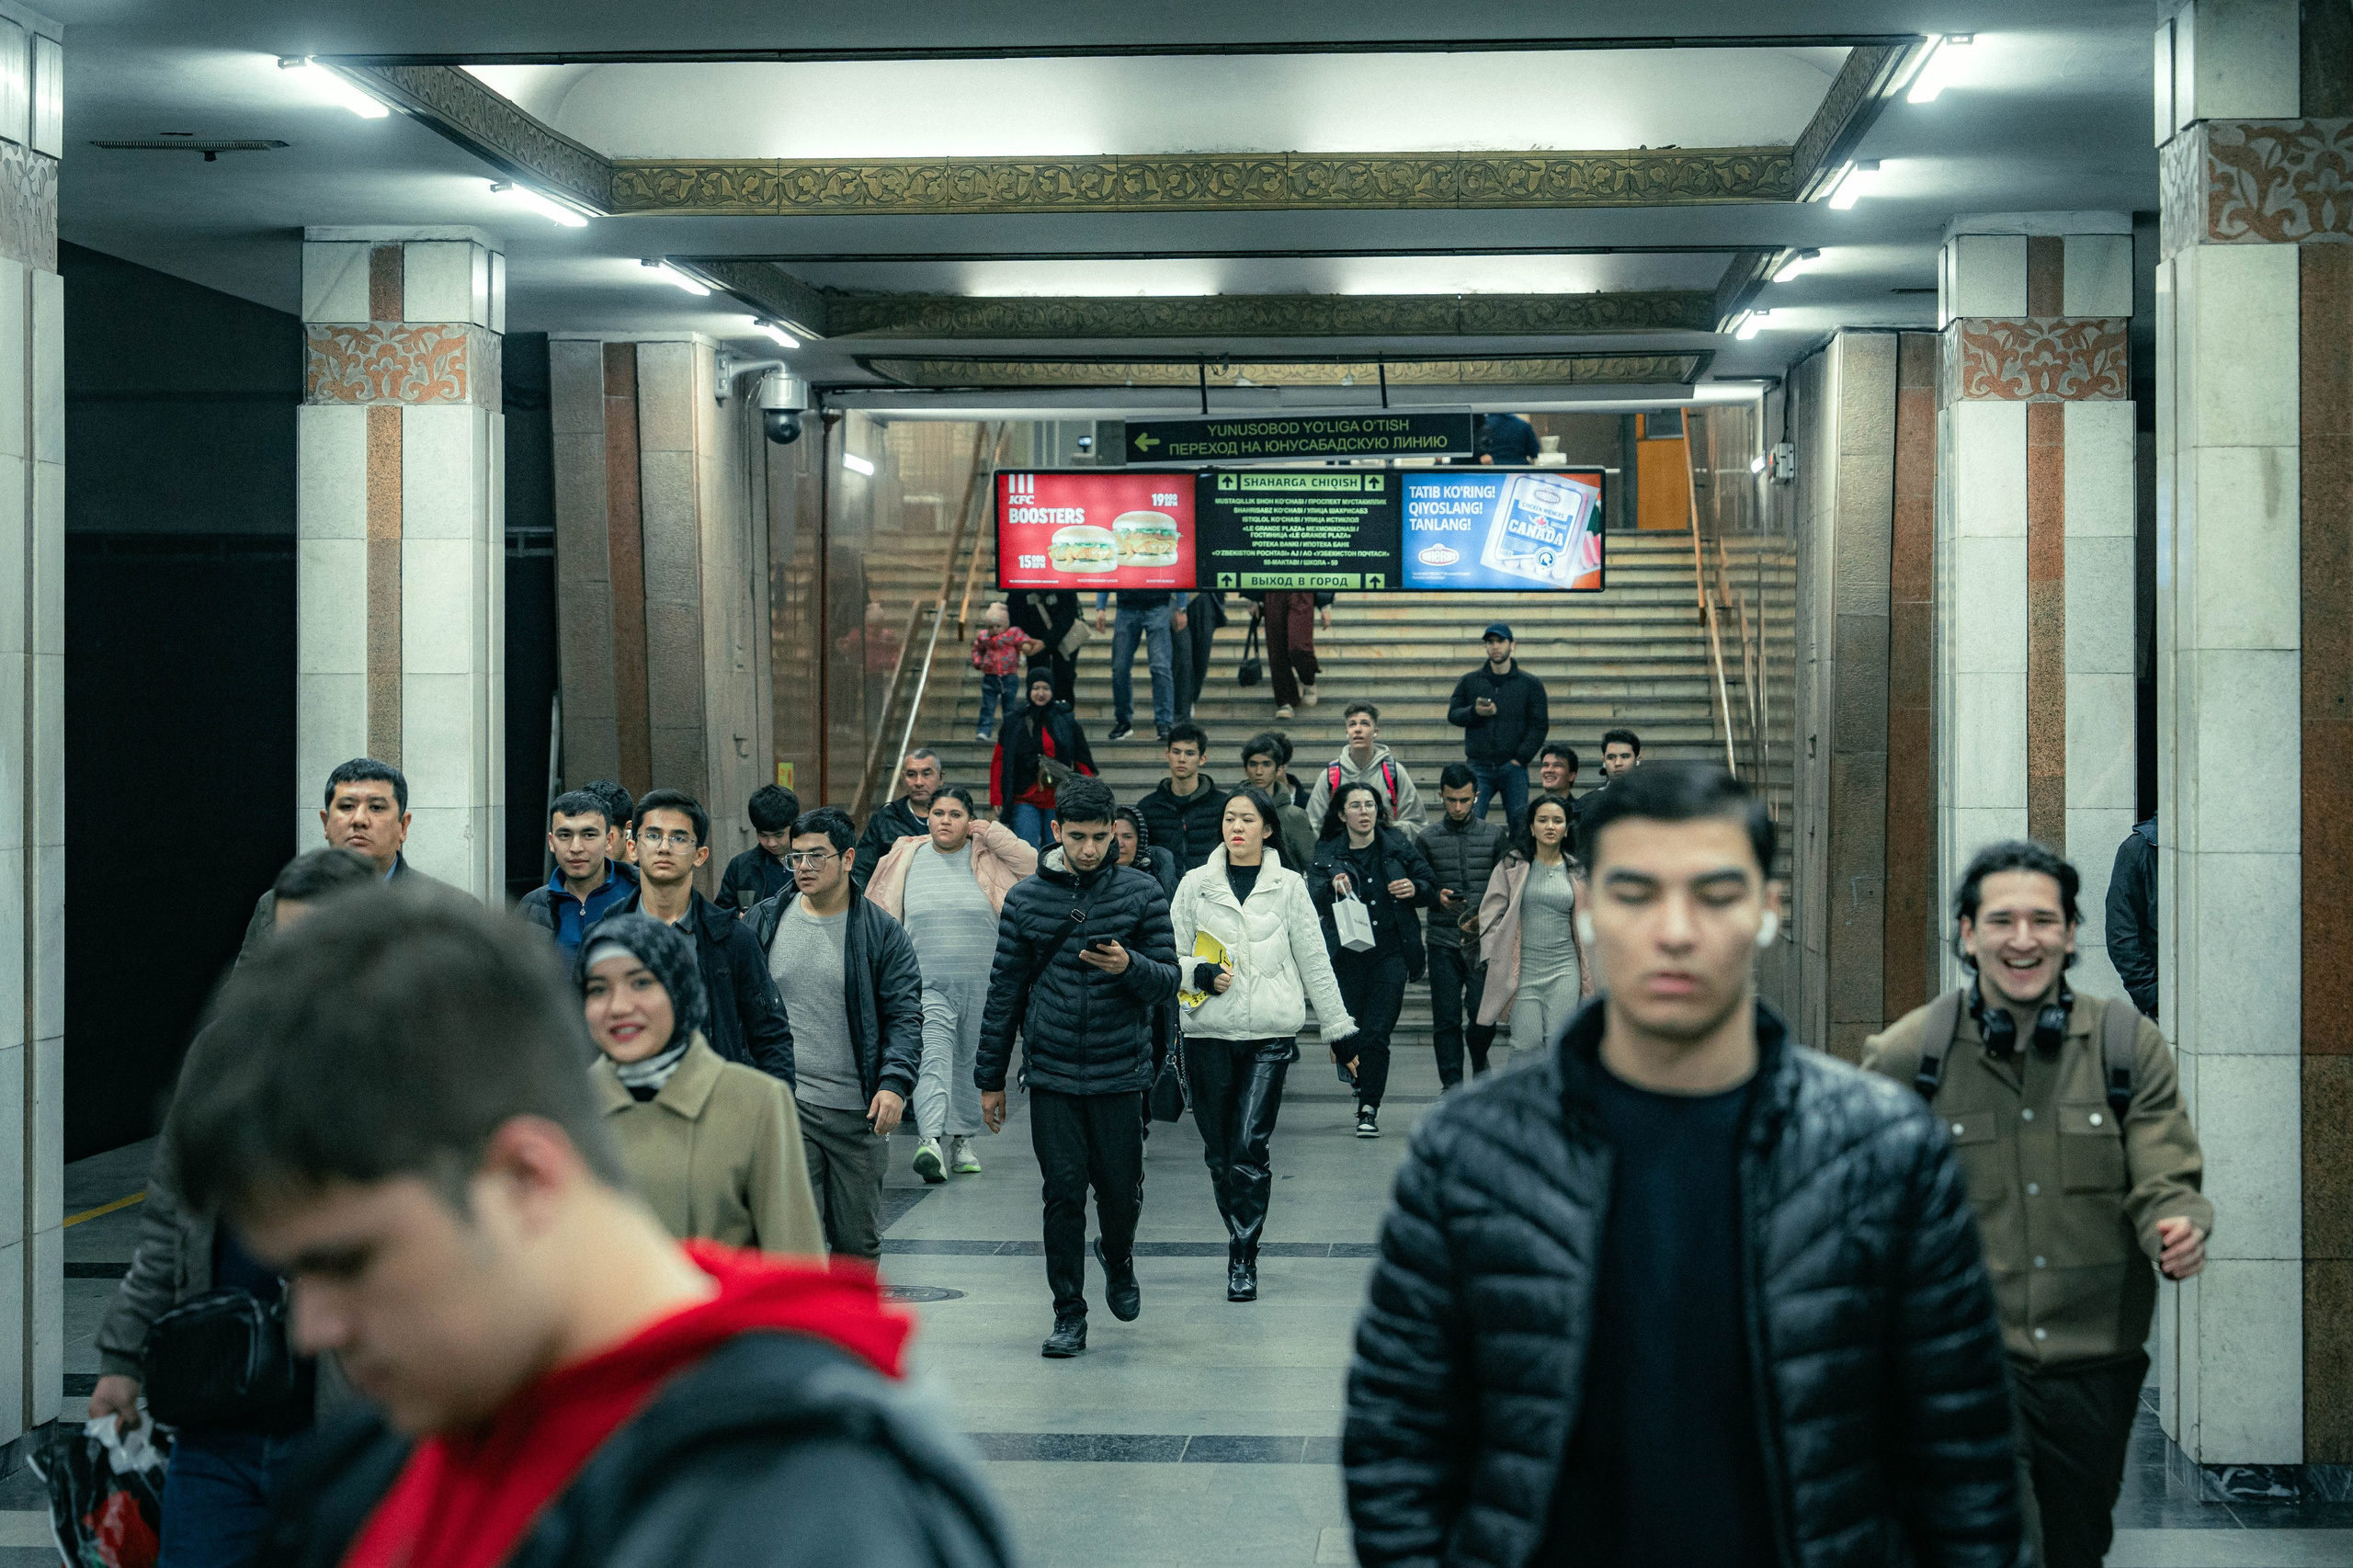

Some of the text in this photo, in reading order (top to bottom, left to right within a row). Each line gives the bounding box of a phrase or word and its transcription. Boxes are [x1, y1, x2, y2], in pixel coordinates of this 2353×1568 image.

[1207, 422, 1300, 437] YUNUSOBOD
[1169, 435, 1448, 456] ПЕРЕХОД НА ЮНУСАБАДСКУЮ ЛИНИЮ
[1244, 478, 1358, 489] SHAHARGA CHIQISH
[1409, 486, 1495, 498] TATIB KO'RING!
[1008, 495, 1034, 505] KFC
[1409, 502, 1483, 516] QIYOSLANG!
[1522, 502, 1543, 512] CHICKEN
[1008, 507, 1085, 524] BOOSTERS
[1409, 518, 1471, 531] TANLANG!
[1508, 519, 1563, 546] CANADA
[1252, 577, 1347, 586] ВЫХОД В ГОРОД
